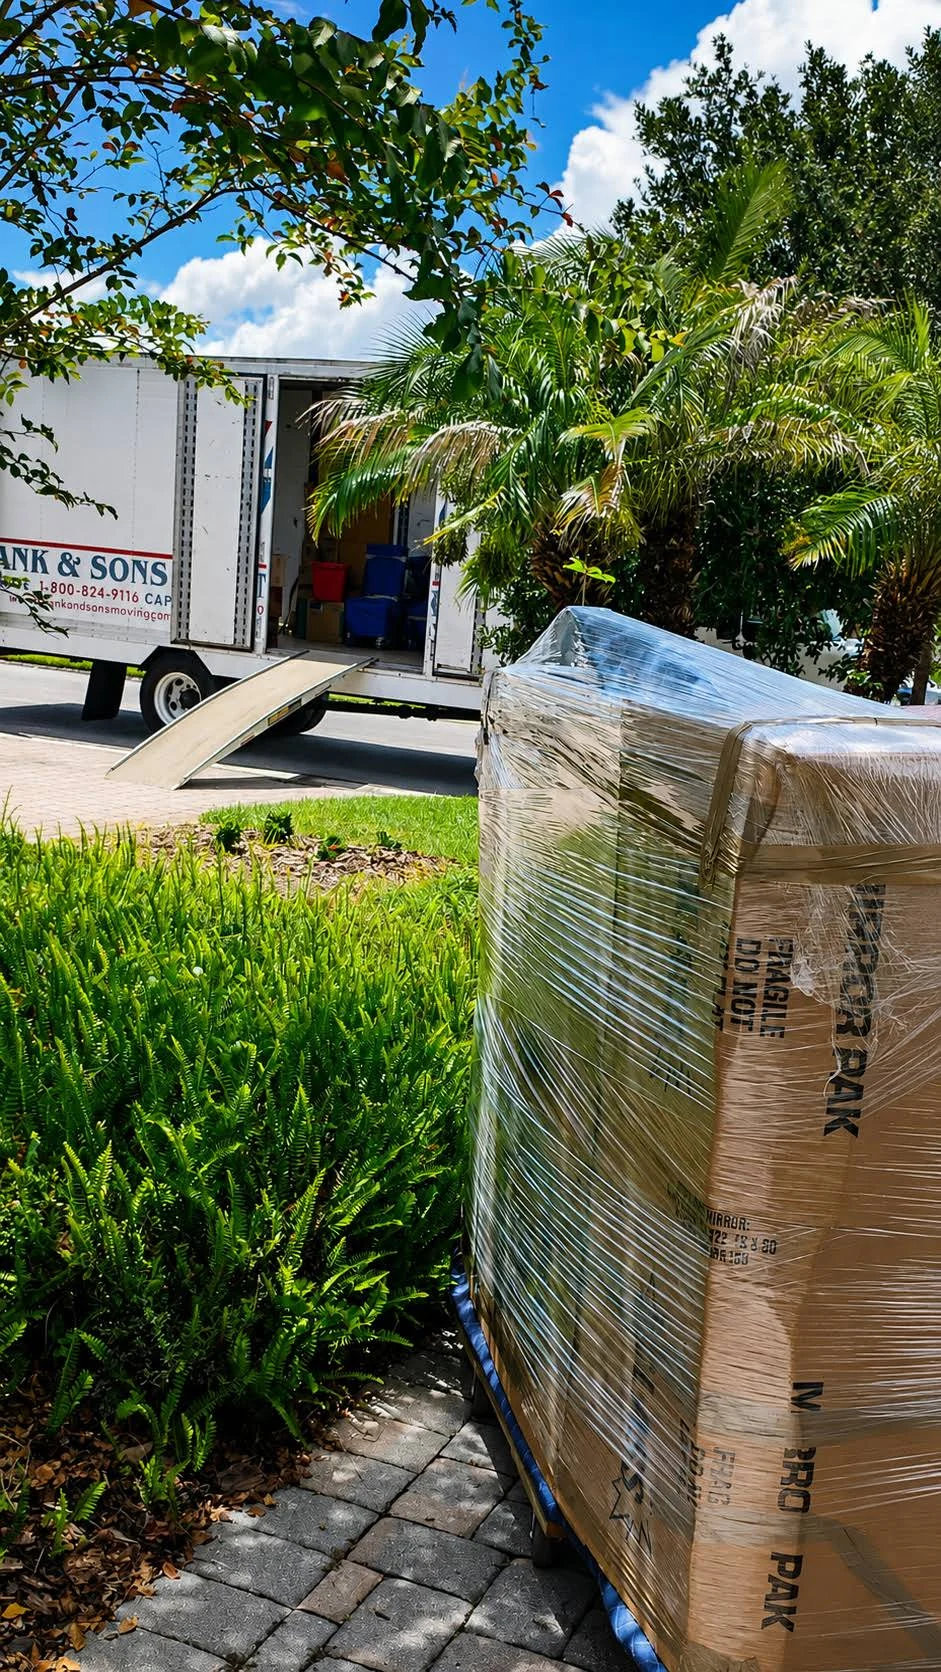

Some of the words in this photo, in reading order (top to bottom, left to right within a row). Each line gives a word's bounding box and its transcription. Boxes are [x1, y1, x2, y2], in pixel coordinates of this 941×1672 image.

[40, 580, 139, 603] 1-800-824-9116
[57, 552, 81, 577] &
[90, 555, 168, 587] SONS
[734, 937, 762, 975] DO
[729, 981, 758, 1032] NOT
[759, 936, 794, 1039] FRAGILE
[823, 1047, 869, 1138] PAK
[750, 1551, 804, 1633] PAK
